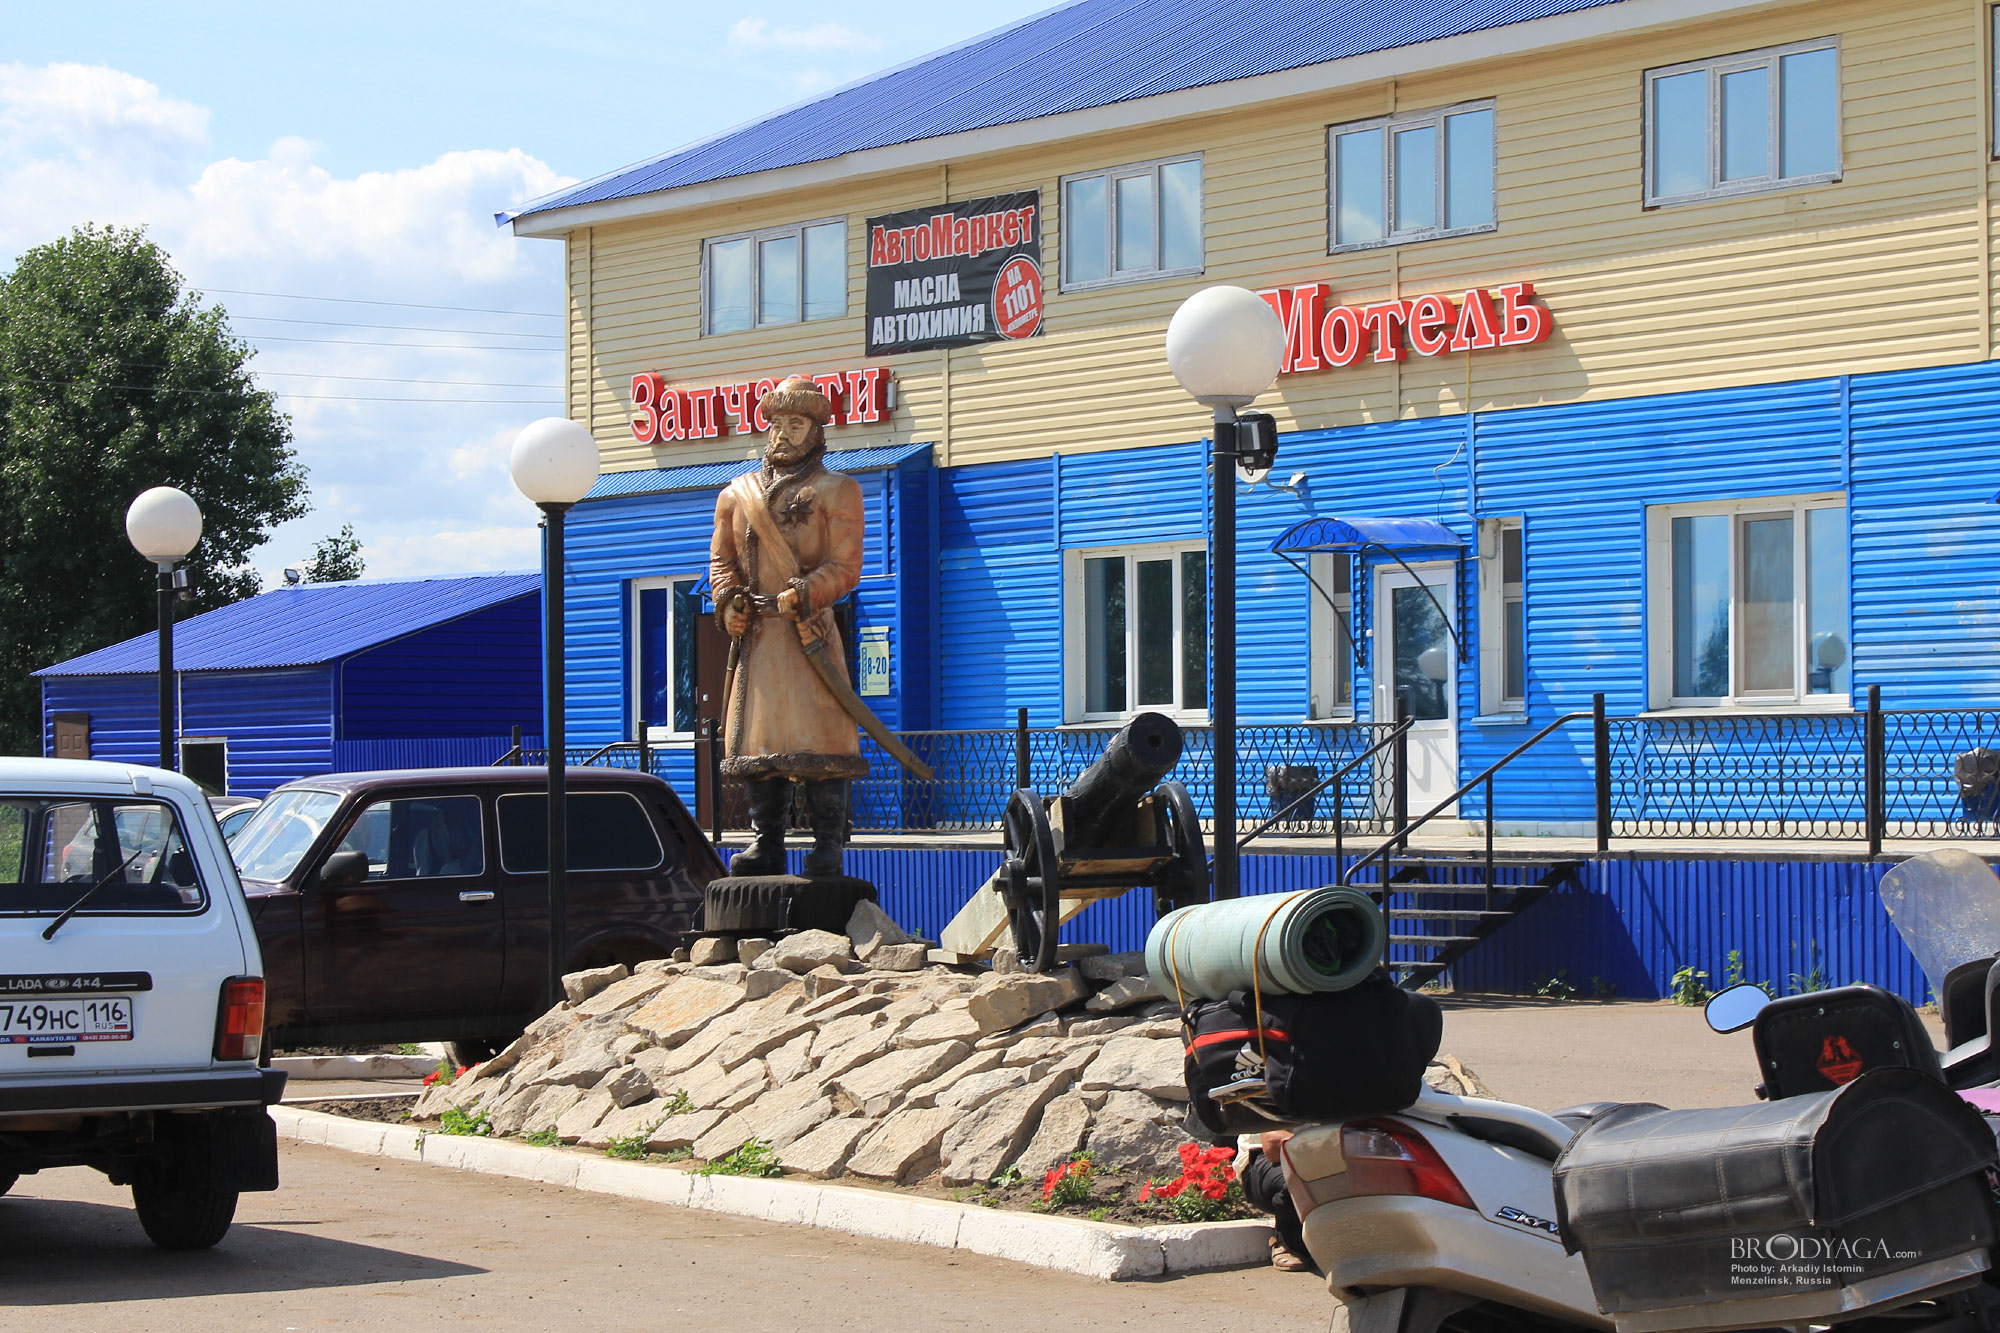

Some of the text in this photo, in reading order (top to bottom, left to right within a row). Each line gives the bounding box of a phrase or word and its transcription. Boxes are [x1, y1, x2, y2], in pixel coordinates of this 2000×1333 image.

[870, 205, 1035, 267] АвтоМаркет
[894, 273, 961, 309] МАСЛА
[1006, 265, 1022, 288] НА
[1003, 279, 1036, 319] 1101
[872, 303, 986, 345] АВТОХИМИЯ
[1257, 283, 1548, 374] Мотель
[630, 367, 886, 445] Запчати
[868, 656, 887, 675] 8-20
[8, 979, 43, 990] LADA
[86, 1002, 123, 1022] 116
[95, 1022, 114, 1030] RUS
